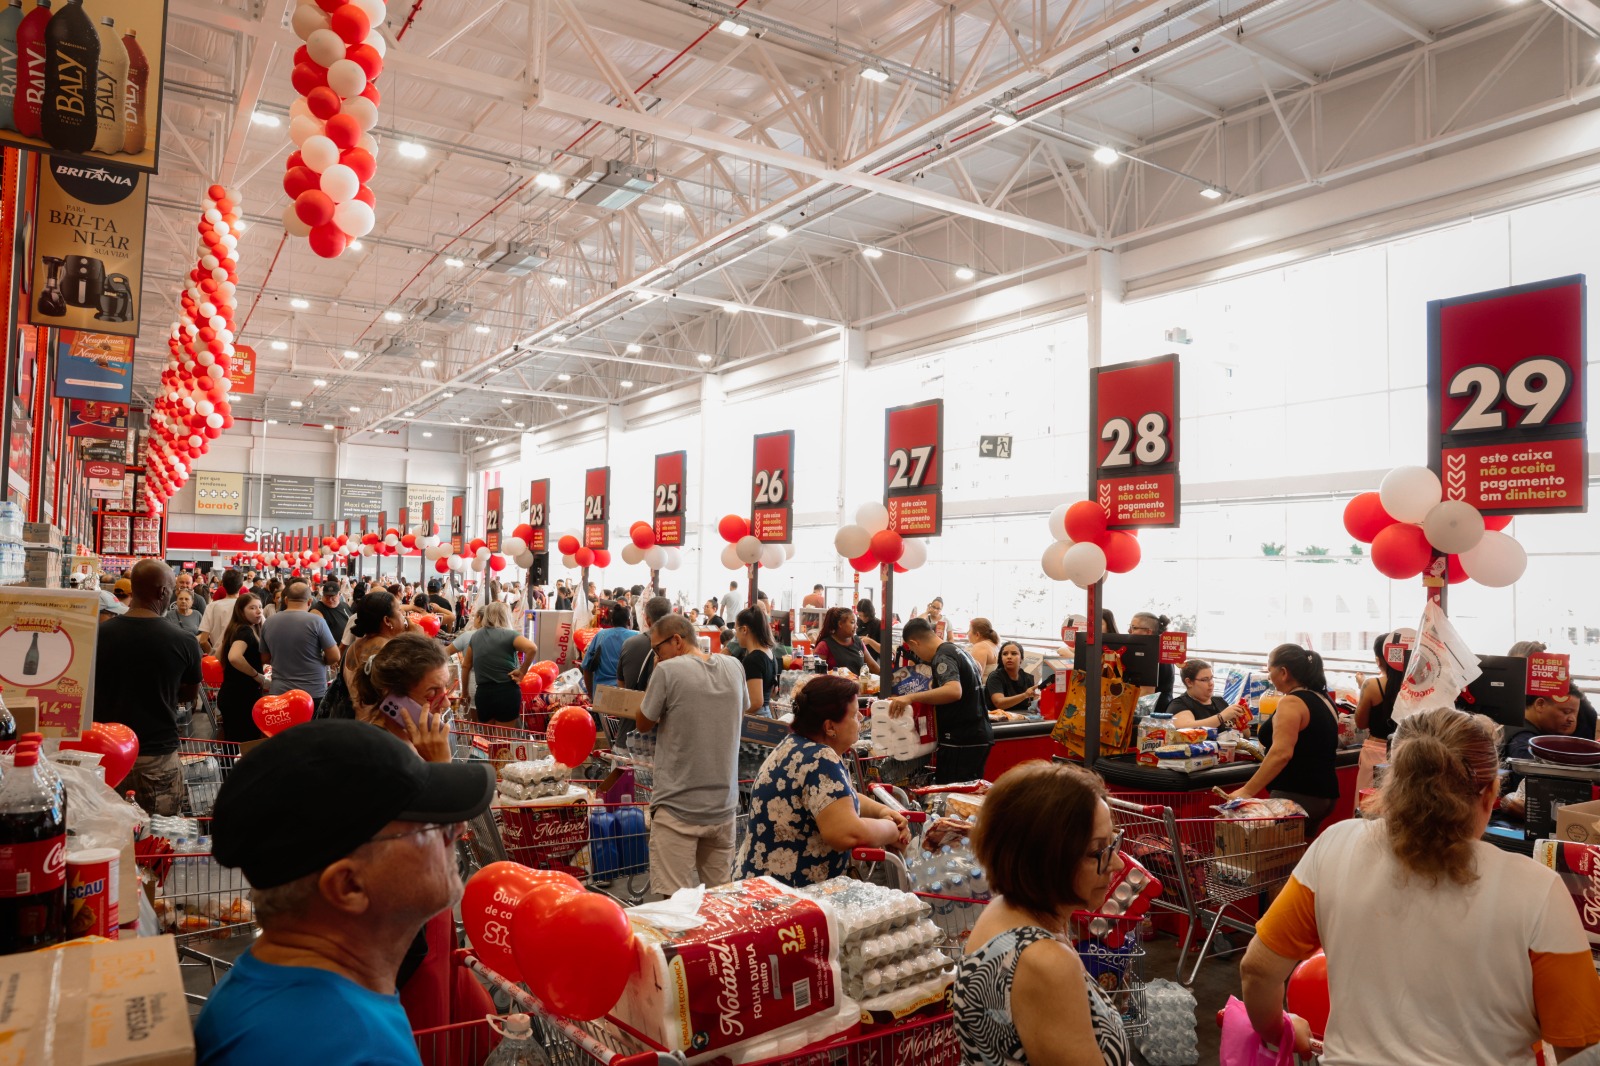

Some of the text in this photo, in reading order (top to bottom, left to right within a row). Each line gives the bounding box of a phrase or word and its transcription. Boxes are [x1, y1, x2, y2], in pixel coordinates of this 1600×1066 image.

[56, 49, 87, 117] BALY
[66, 205, 87, 213] PARA
[94, 248, 129, 259] SUA VIDA
[1449, 357, 1568, 432] 29
[1101, 412, 1169, 467] 28
[1480, 449, 1553, 464] este caixa
[889, 446, 932, 488] 27
[1480, 462, 1556, 476] não aceita
[755, 469, 783, 503] 26
[1118, 481, 1158, 491] este caixa
[1480, 475, 1565, 492] pagamento
[655, 483, 678, 513] 25
[1118, 491, 1160, 500] não aceita
[1480, 487, 1567, 502] em dinheiro
[197, 499, 239, 510] barato?
[585, 495, 602, 519] 24
[912, 506, 928, 514] aceita
[913, 499, 927, 507] caixa
[1118, 501, 1164, 512] pagamento
[487, 510, 497, 530] 22
[531, 504, 543, 526] 23
[901, 515, 930, 524] pagamento
[1132, 509, 1165, 518] dinheiro
[452, 516, 460, 534] 21
[556, 623, 571, 666] Red Bull
[1531, 670, 1554, 678] STOK
[1532, 664, 1558, 672] CLUBE
[59, 685, 82, 695] Stok
[265, 711, 291, 726] Stok
[1142, 740, 1162, 751] Limpol
[67, 878, 105, 900] SCAU
[485, 905, 498, 917] de
[778, 926, 799, 955] 32
[796, 924, 806, 950] Rolos
[730, 943, 740, 970] Premium
[746, 943, 762, 1019] FOLHA DUPLA
[760, 962, 769, 994] neutro
[673, 961, 690, 1046] EMBALAGEM ECONÔMICA
